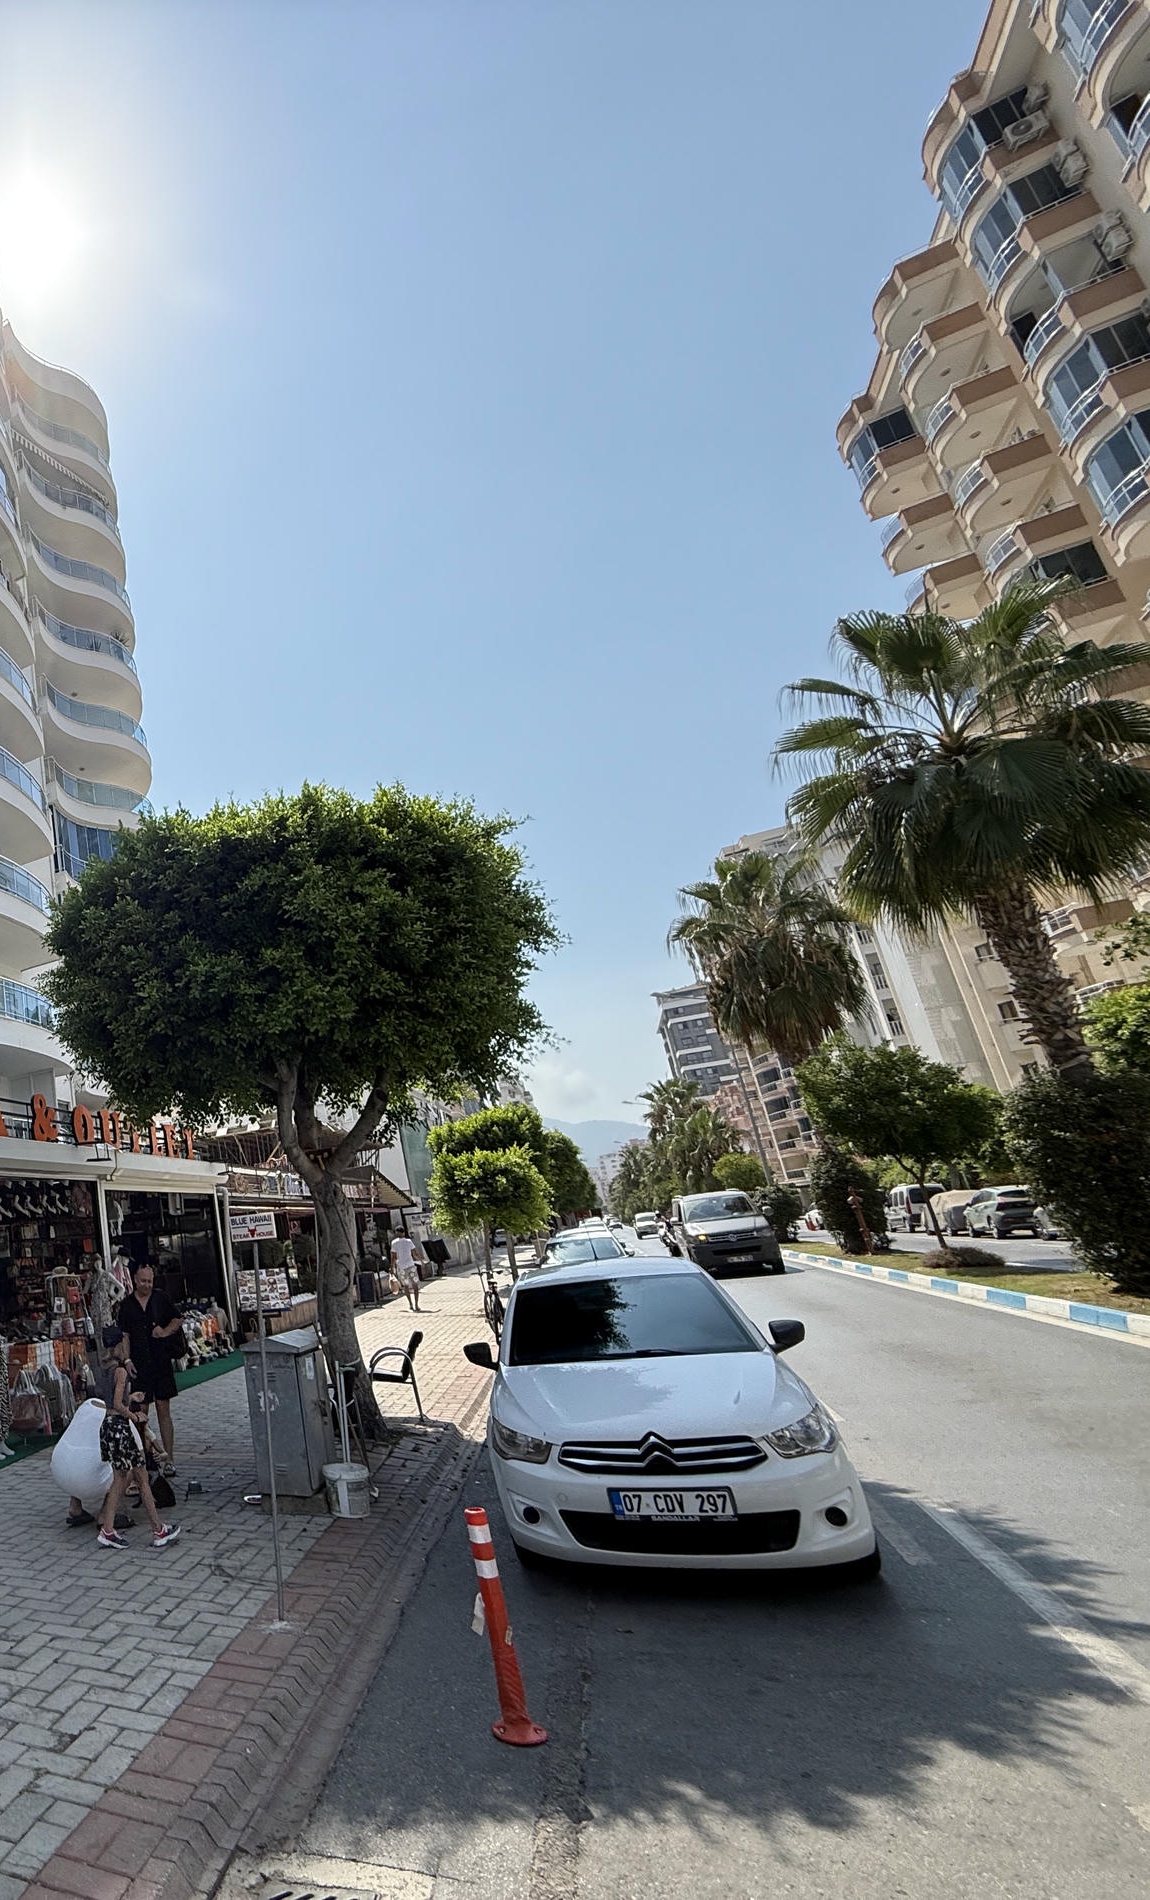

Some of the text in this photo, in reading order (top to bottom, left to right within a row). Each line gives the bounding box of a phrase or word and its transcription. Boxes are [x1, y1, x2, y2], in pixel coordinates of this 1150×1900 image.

[31, 1093, 58, 1142] &
[230, 1214, 272, 1226] BLUE HAWAII
[232, 1230, 274, 1241] STEAK HOUSE
[622, 1493, 727, 1513] 07 CDV 297
